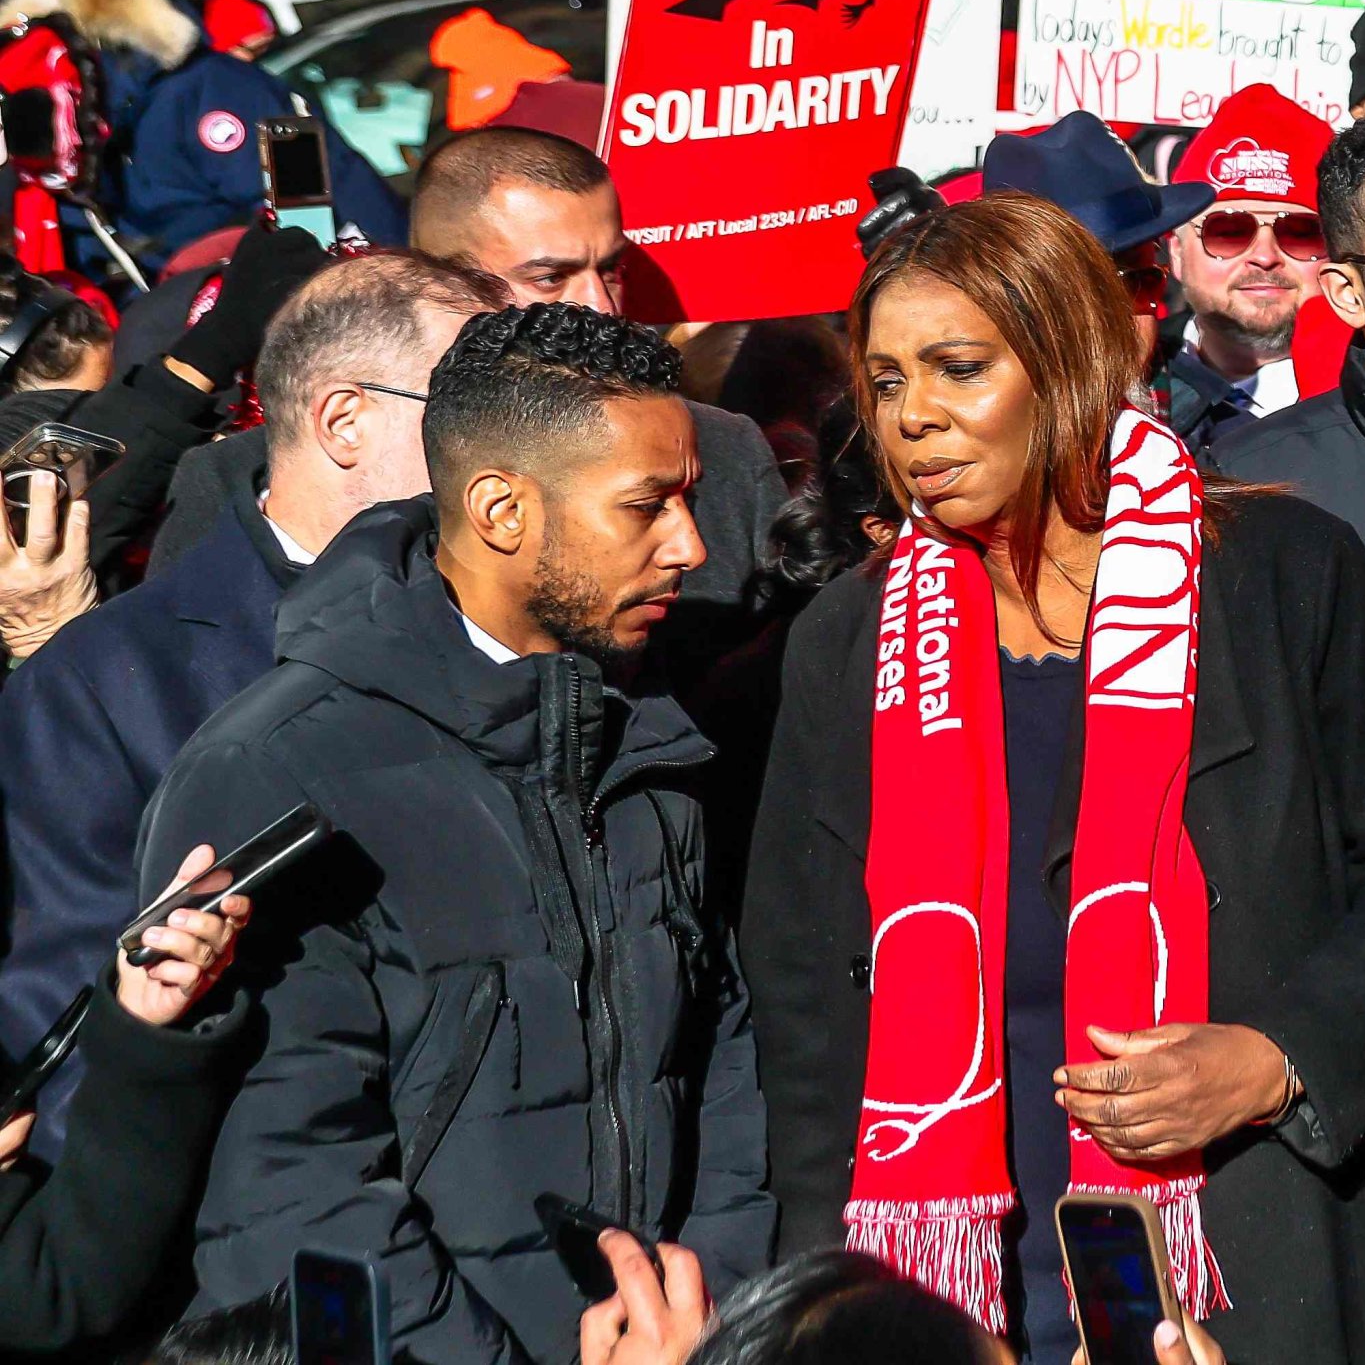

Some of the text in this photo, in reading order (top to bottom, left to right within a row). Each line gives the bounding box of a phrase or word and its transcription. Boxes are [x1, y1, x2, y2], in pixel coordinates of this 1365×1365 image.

[748, 19, 795, 69] In
[1218, 0, 1304, 78] brought
[1316, 15, 1343, 66] to
[618, 63, 901, 147] SOLIDARITY
[1022, 52, 1049, 117] by
[1055, 48, 1141, 118] NYP
[686, 220, 717, 241] AFT
[717, 215, 758, 237] Local
[759, 210, 796, 232] 2334
[806, 197, 859, 223] AFL-CIO
[874, 548, 914, 713] Nurses
[915, 537, 963, 738] National
